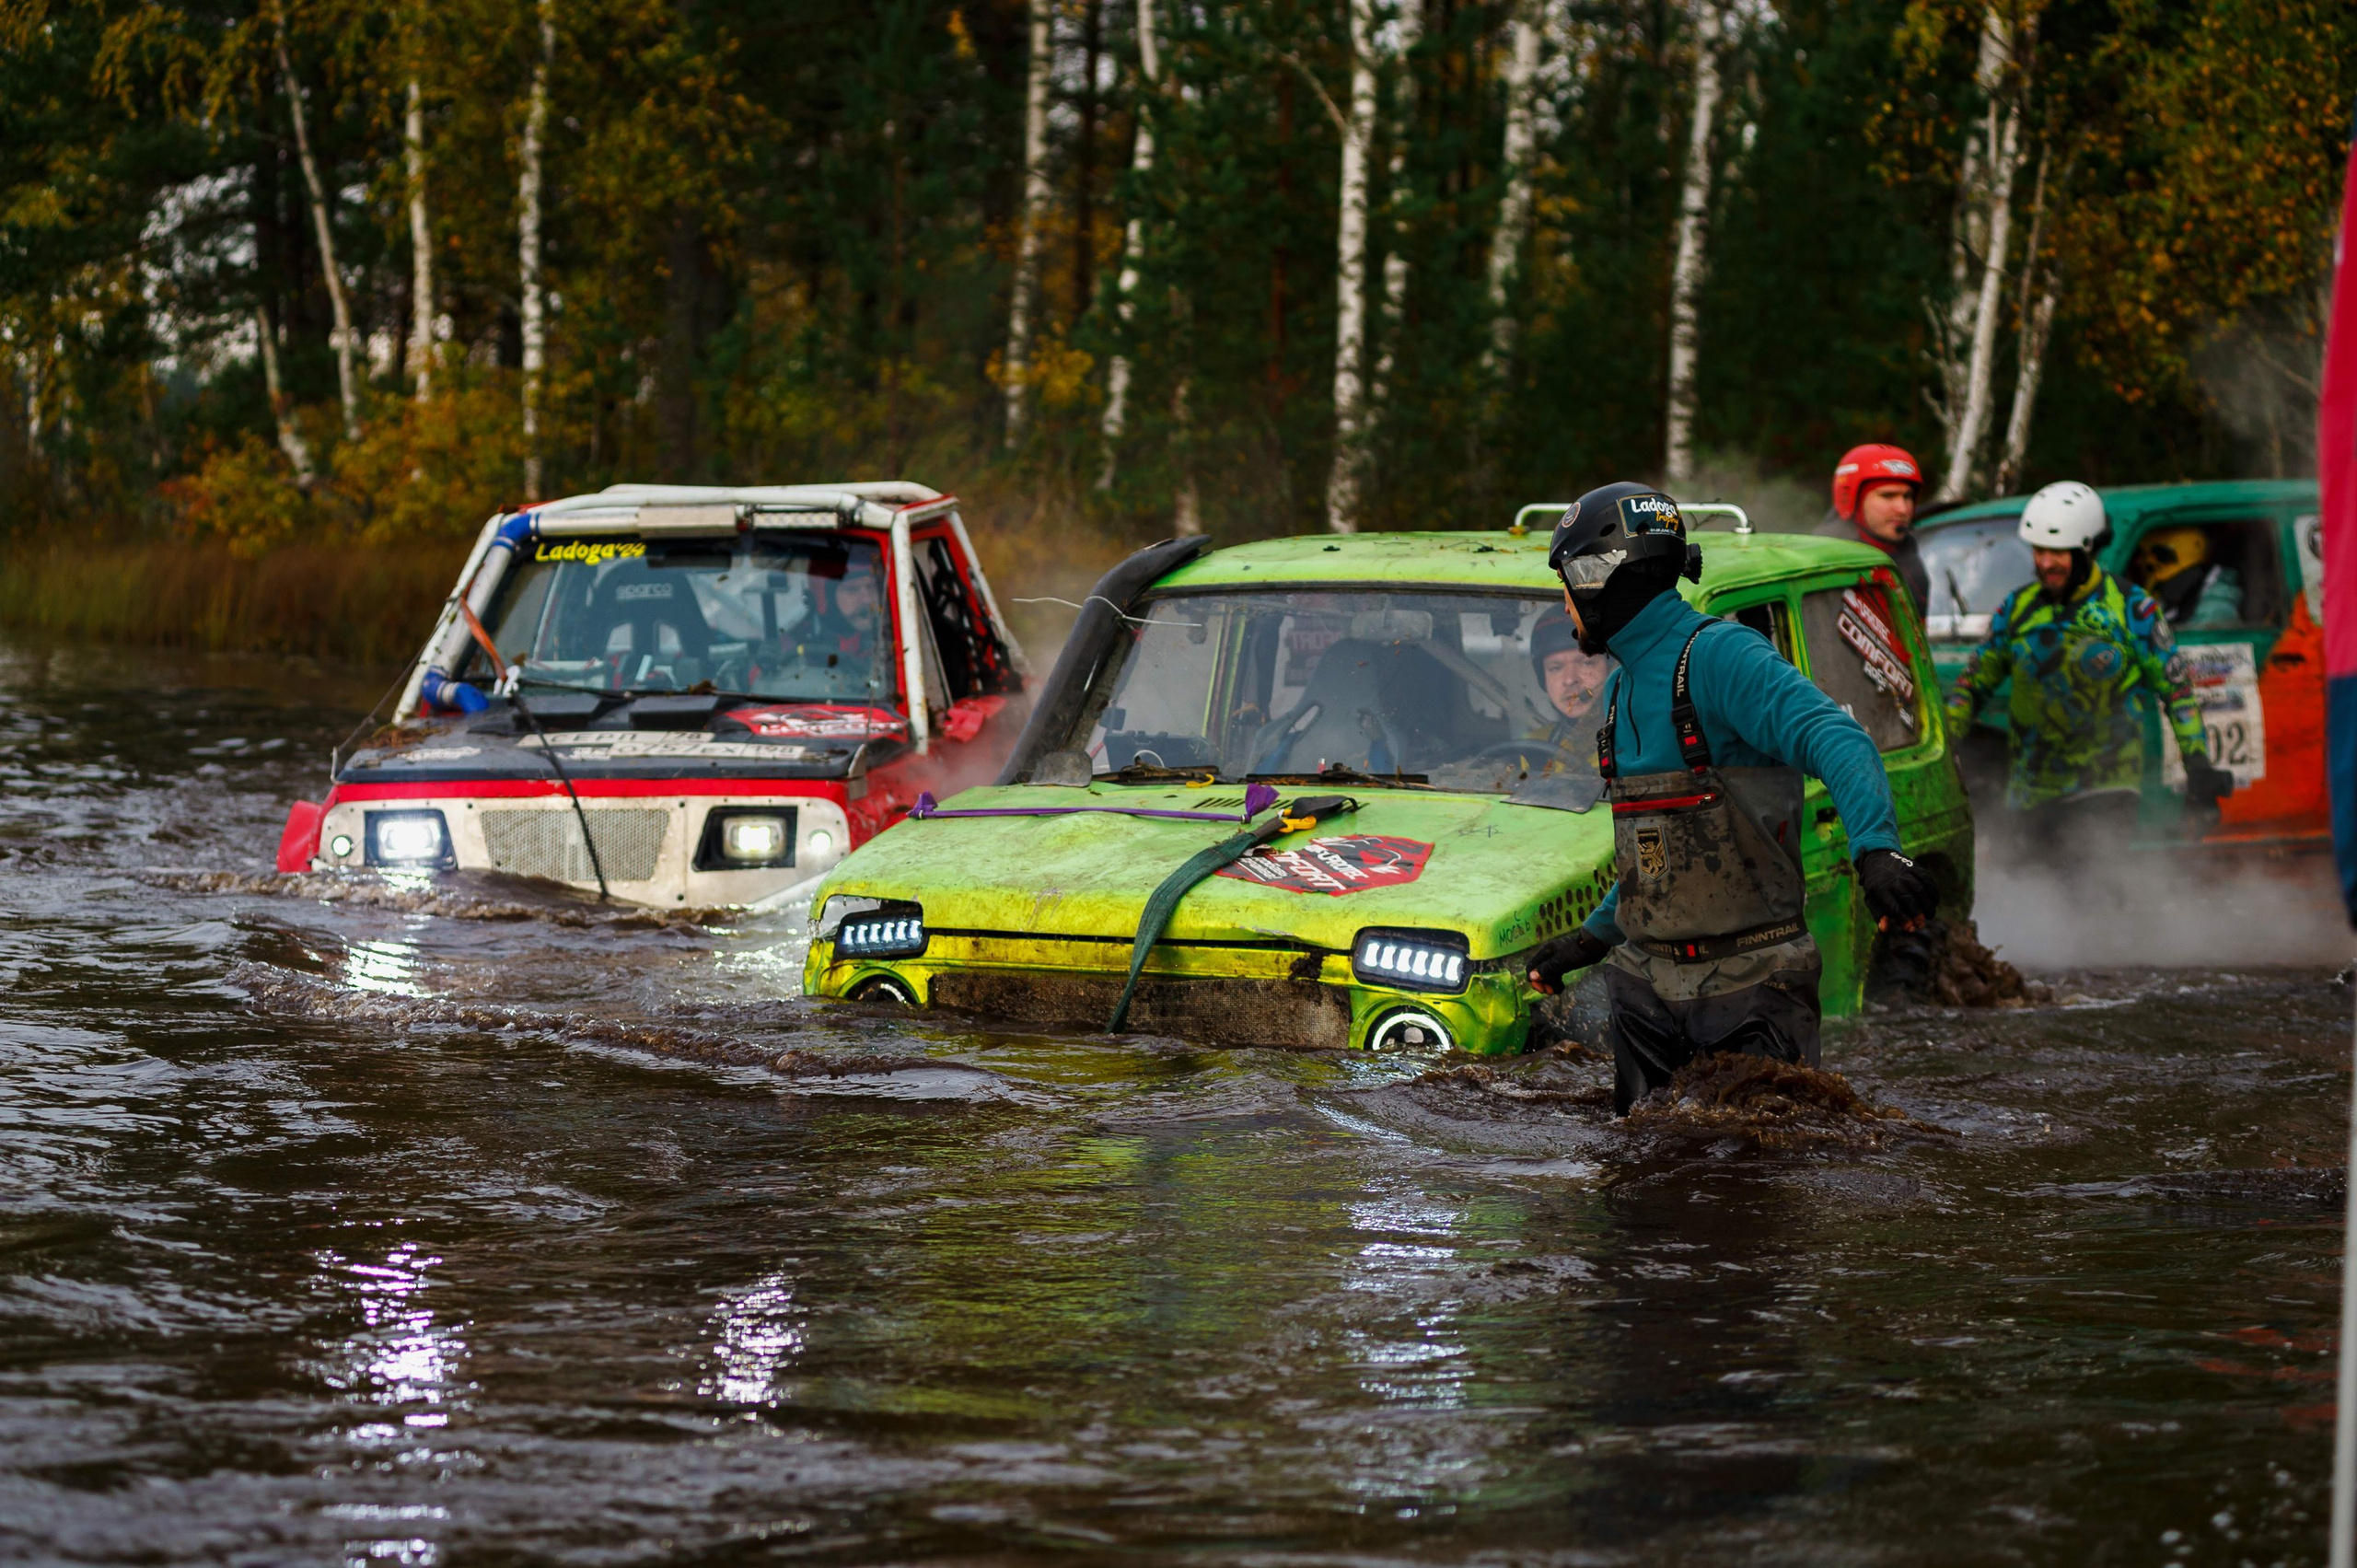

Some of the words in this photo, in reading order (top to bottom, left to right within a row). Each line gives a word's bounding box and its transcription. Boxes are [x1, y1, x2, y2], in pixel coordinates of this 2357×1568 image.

[1630, 497, 1678, 518] Ladoga
[535, 540, 646, 565] Ladoga'24
[1838, 612, 1913, 701] COMFORT
[1736, 923, 1800, 947] FINNTRAIL
